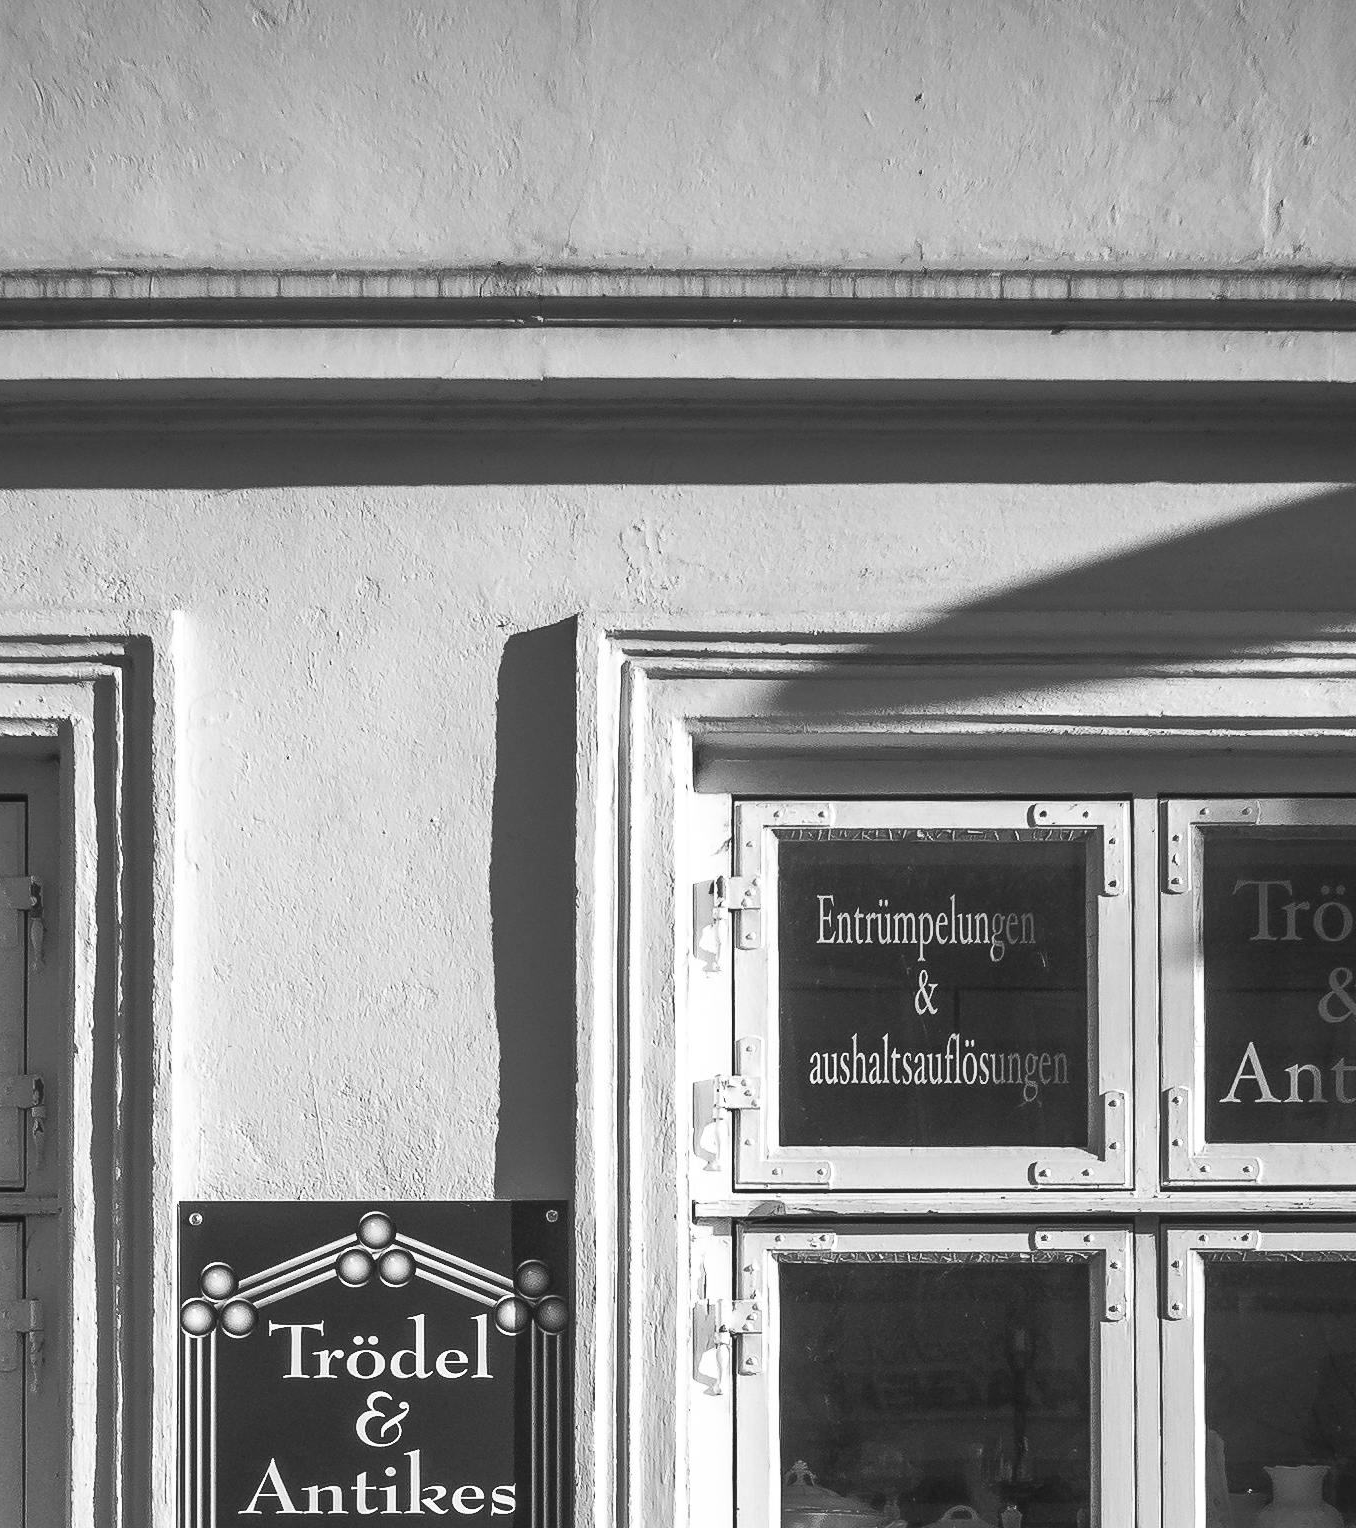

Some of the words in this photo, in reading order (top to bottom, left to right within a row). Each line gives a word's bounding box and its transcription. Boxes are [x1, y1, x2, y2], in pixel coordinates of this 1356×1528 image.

[815, 893, 1036, 962] Entrümpelungen
[913, 969, 939, 1016] &
[268, 1313, 494, 1380] Trödel
[355, 1390, 410, 1448] &
[238, 1449, 516, 1516] Antikes
